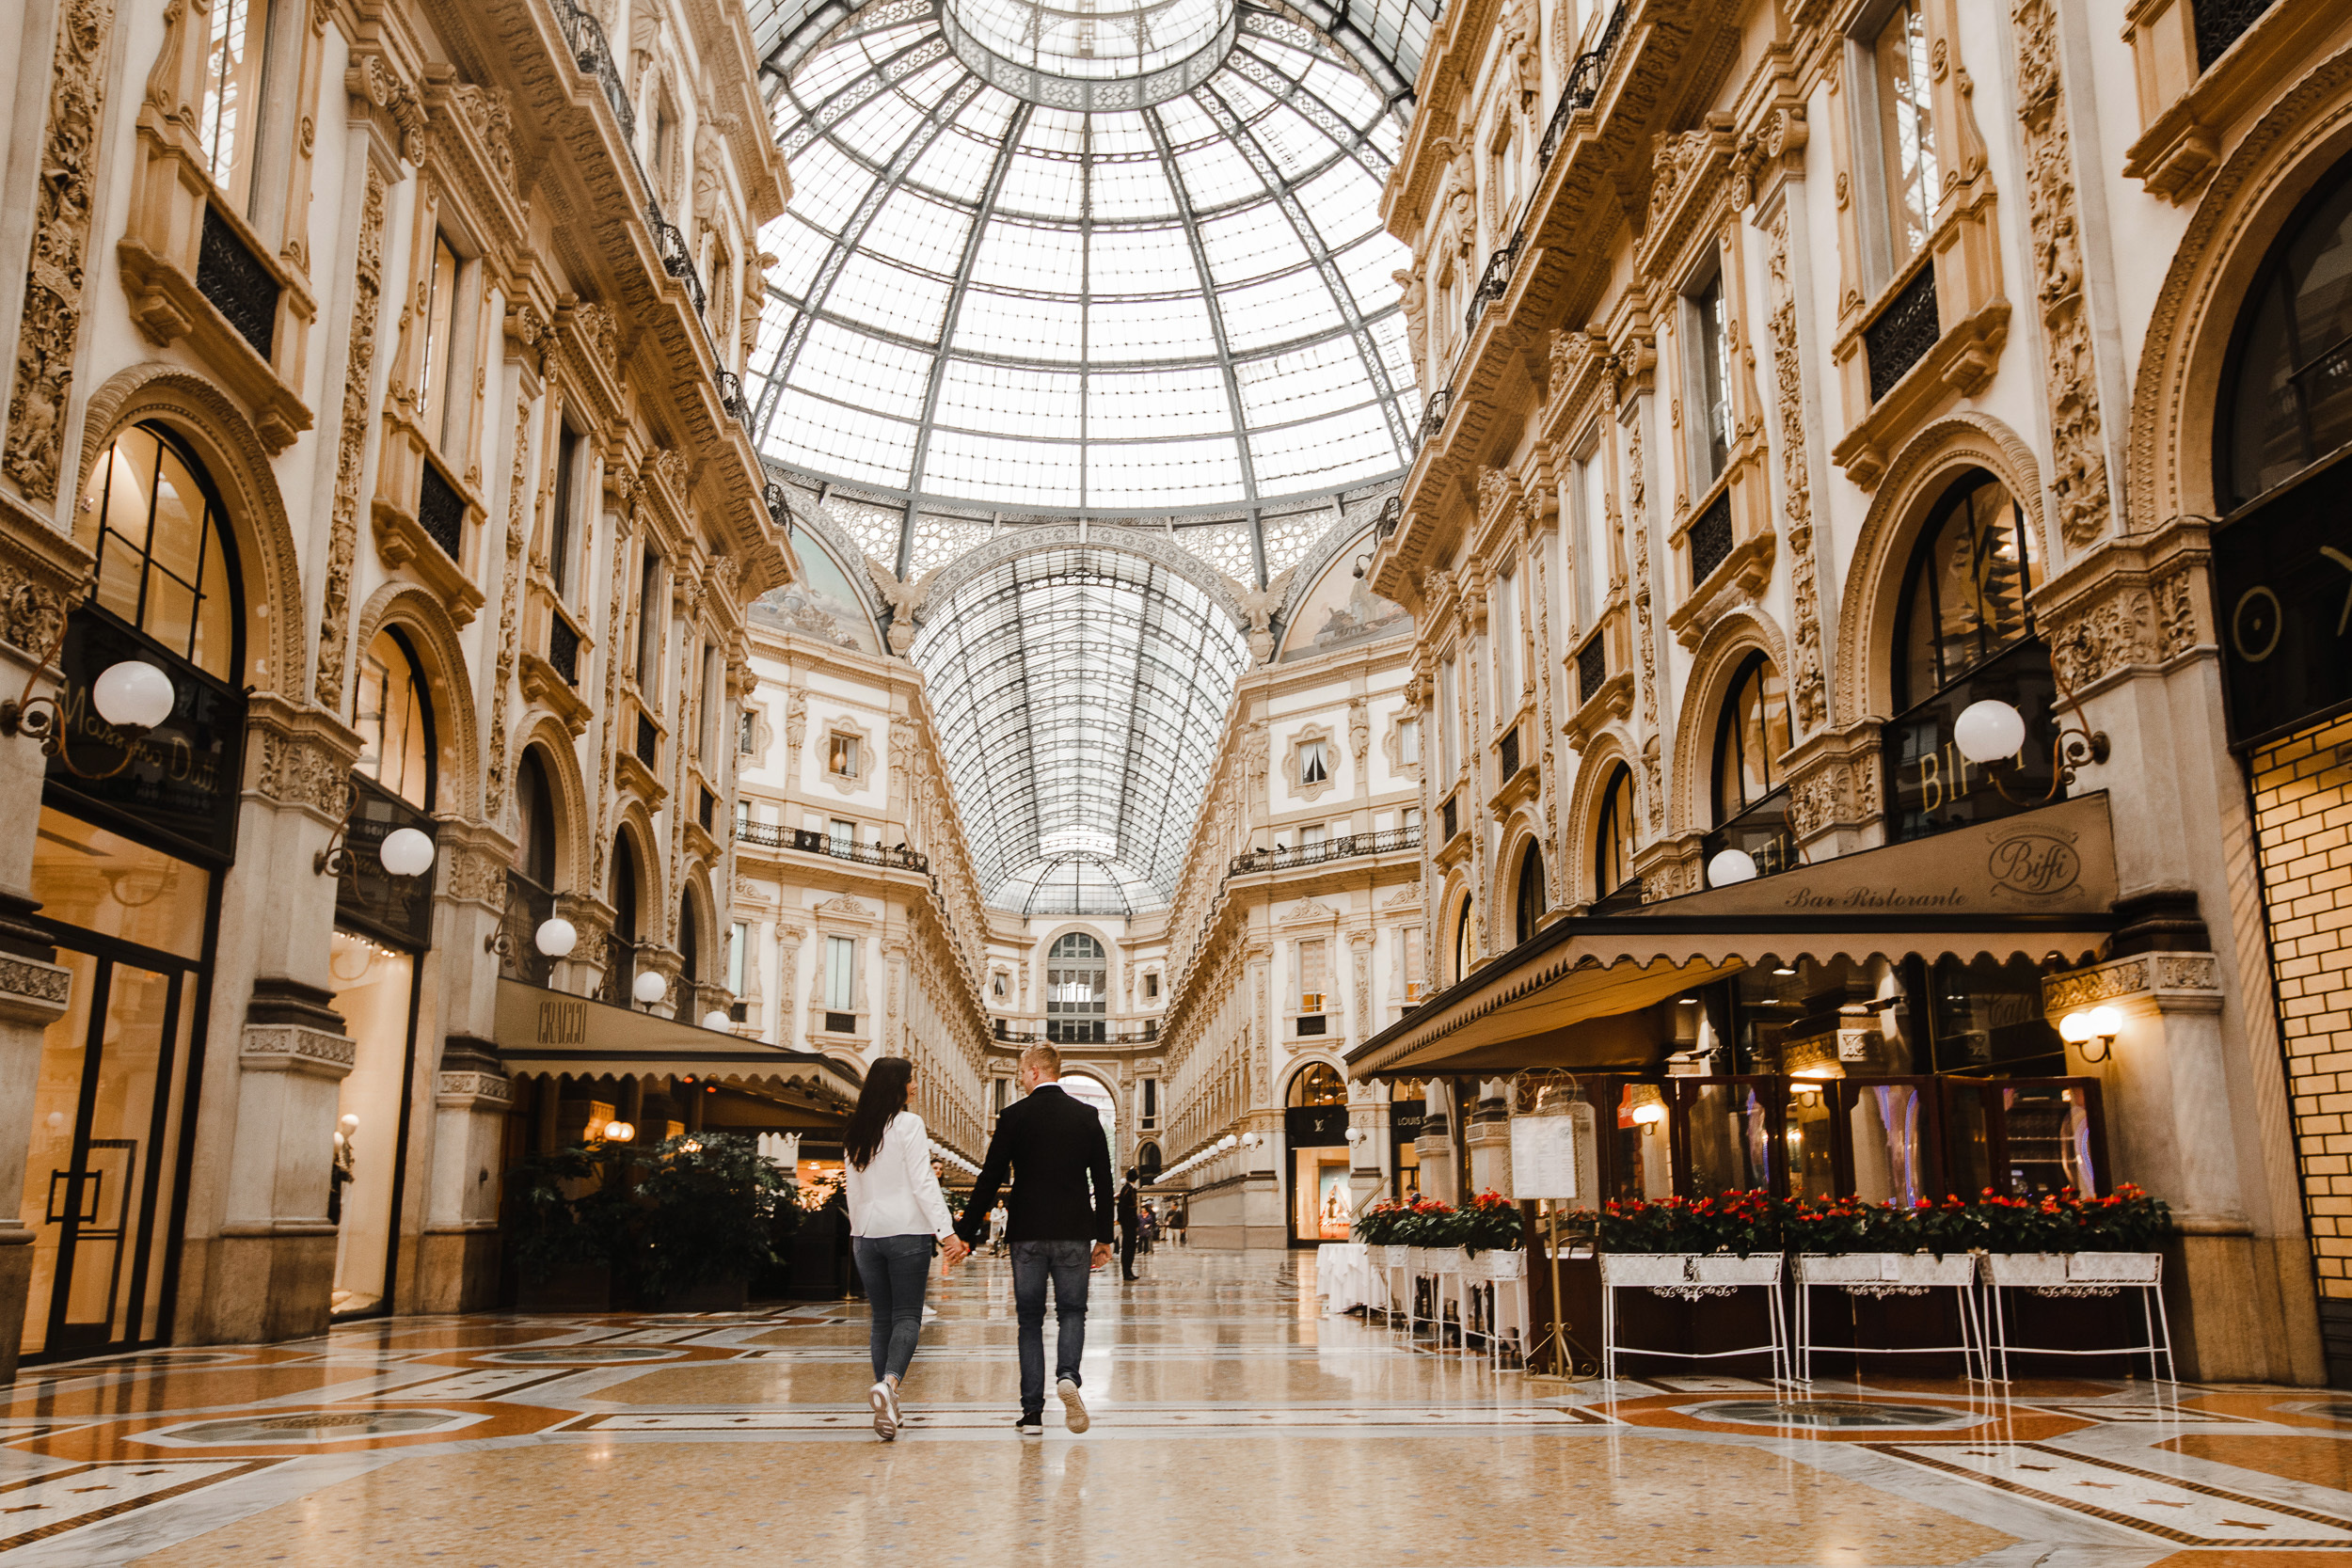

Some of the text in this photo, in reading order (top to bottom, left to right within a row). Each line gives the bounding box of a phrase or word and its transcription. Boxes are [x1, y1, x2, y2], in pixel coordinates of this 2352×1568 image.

[56, 679, 163, 768] Massmo
[1919, 705, 2026, 816] BIF
[1996, 837, 2073, 893] Biffi
[1786, 886, 1970, 908] Bar Ristorante
[537, 1001, 587, 1044] CRACCO
[1397, 1116, 1421, 1127] LOUIS
